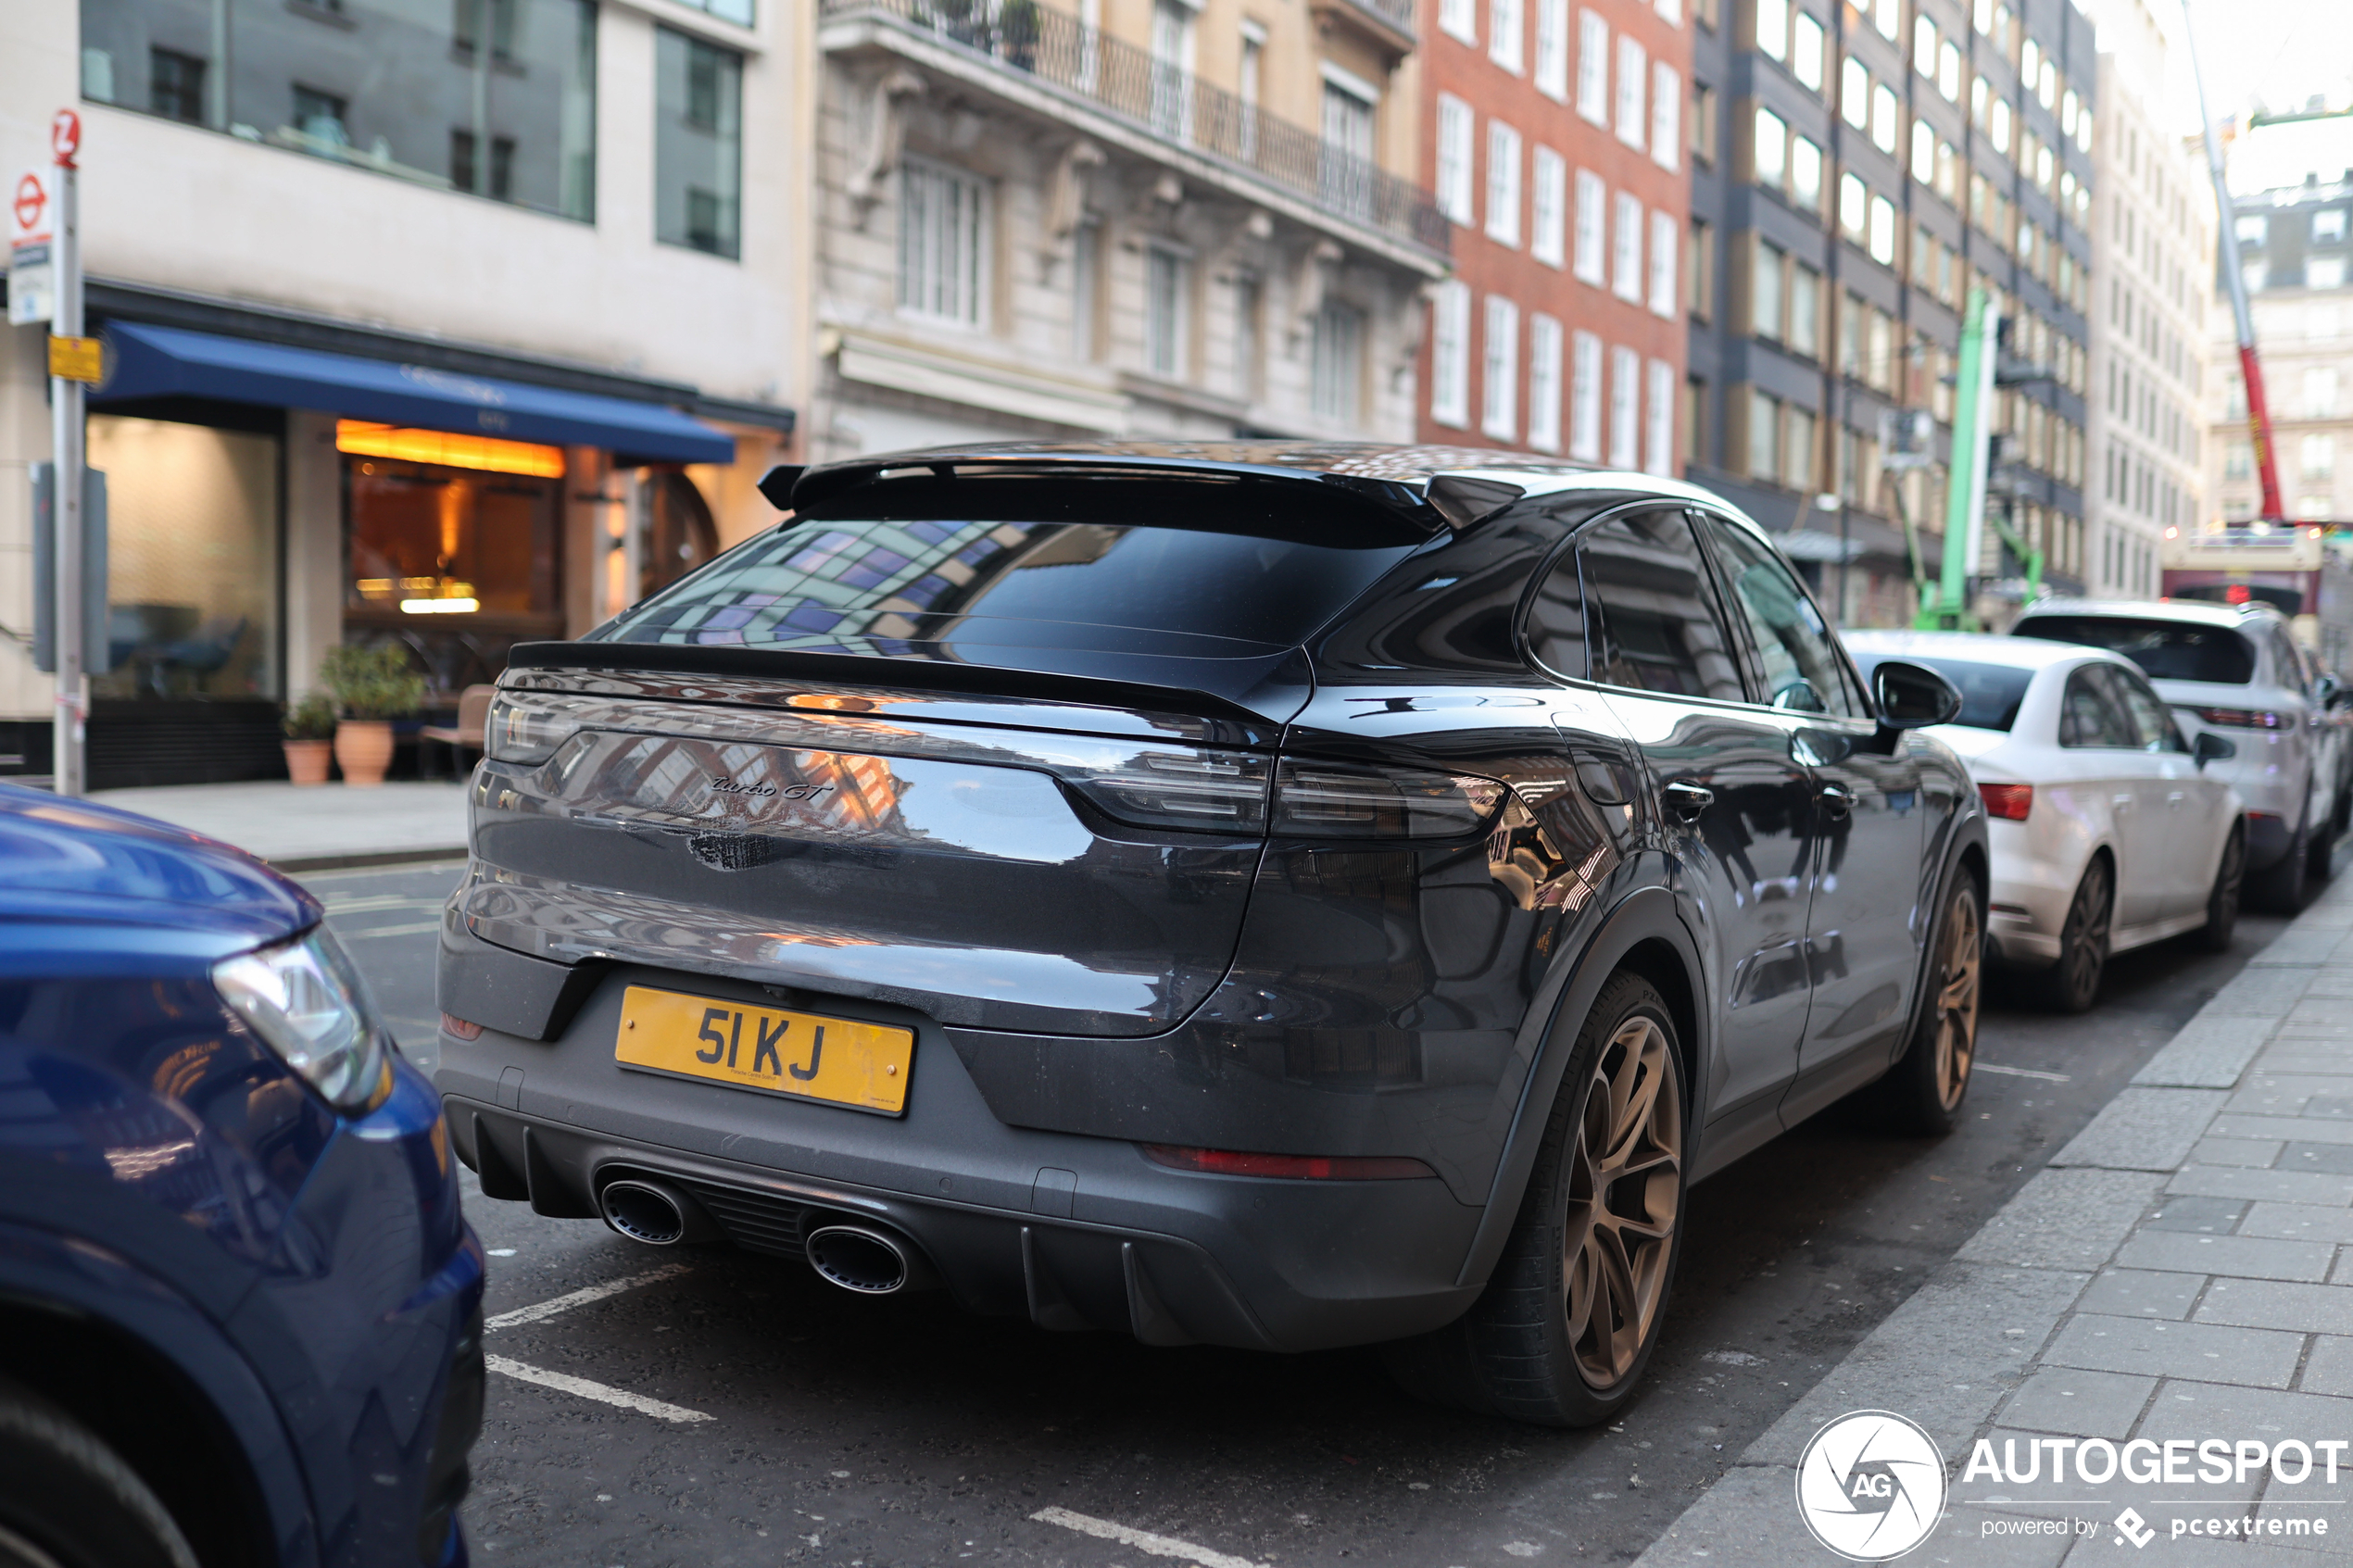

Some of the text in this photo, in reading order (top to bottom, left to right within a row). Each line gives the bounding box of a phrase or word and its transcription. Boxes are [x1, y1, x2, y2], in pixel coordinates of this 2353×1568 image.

[57, 114, 75, 153] Z
[711, 775, 834, 801] turbo GT
[696, 1007, 824, 1082] 51 KJ
